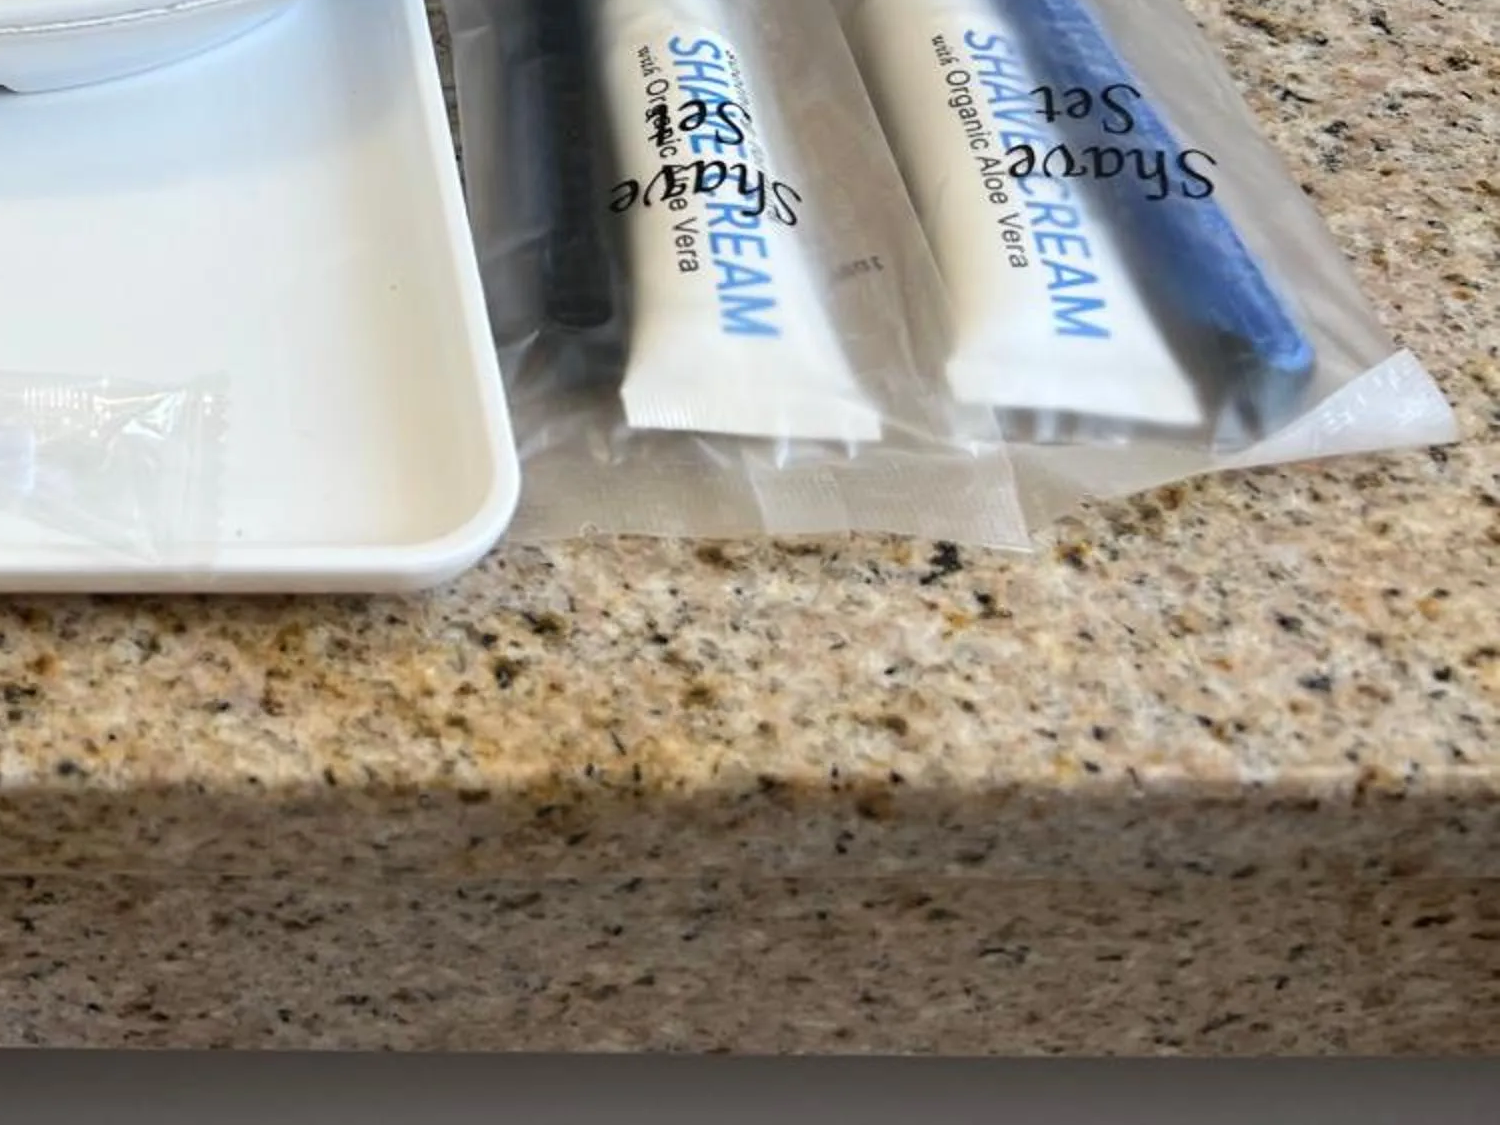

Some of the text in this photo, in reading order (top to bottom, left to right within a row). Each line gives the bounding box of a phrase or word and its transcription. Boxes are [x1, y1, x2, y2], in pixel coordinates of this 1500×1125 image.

[636, 35, 655, 76] with
[671, 218, 701, 273] Vera
[668, 34, 749, 158] SHAVE
[931, 34, 1029, 269] with Organic Aloe Vera
[1028, 82, 1142, 135] Set
[608, 160, 802, 226] Shave
[963, 29, 1112, 340] SHAVE CREAM
[1004, 143, 1217, 201] Shave
[699, 168, 785, 339] CREAM
